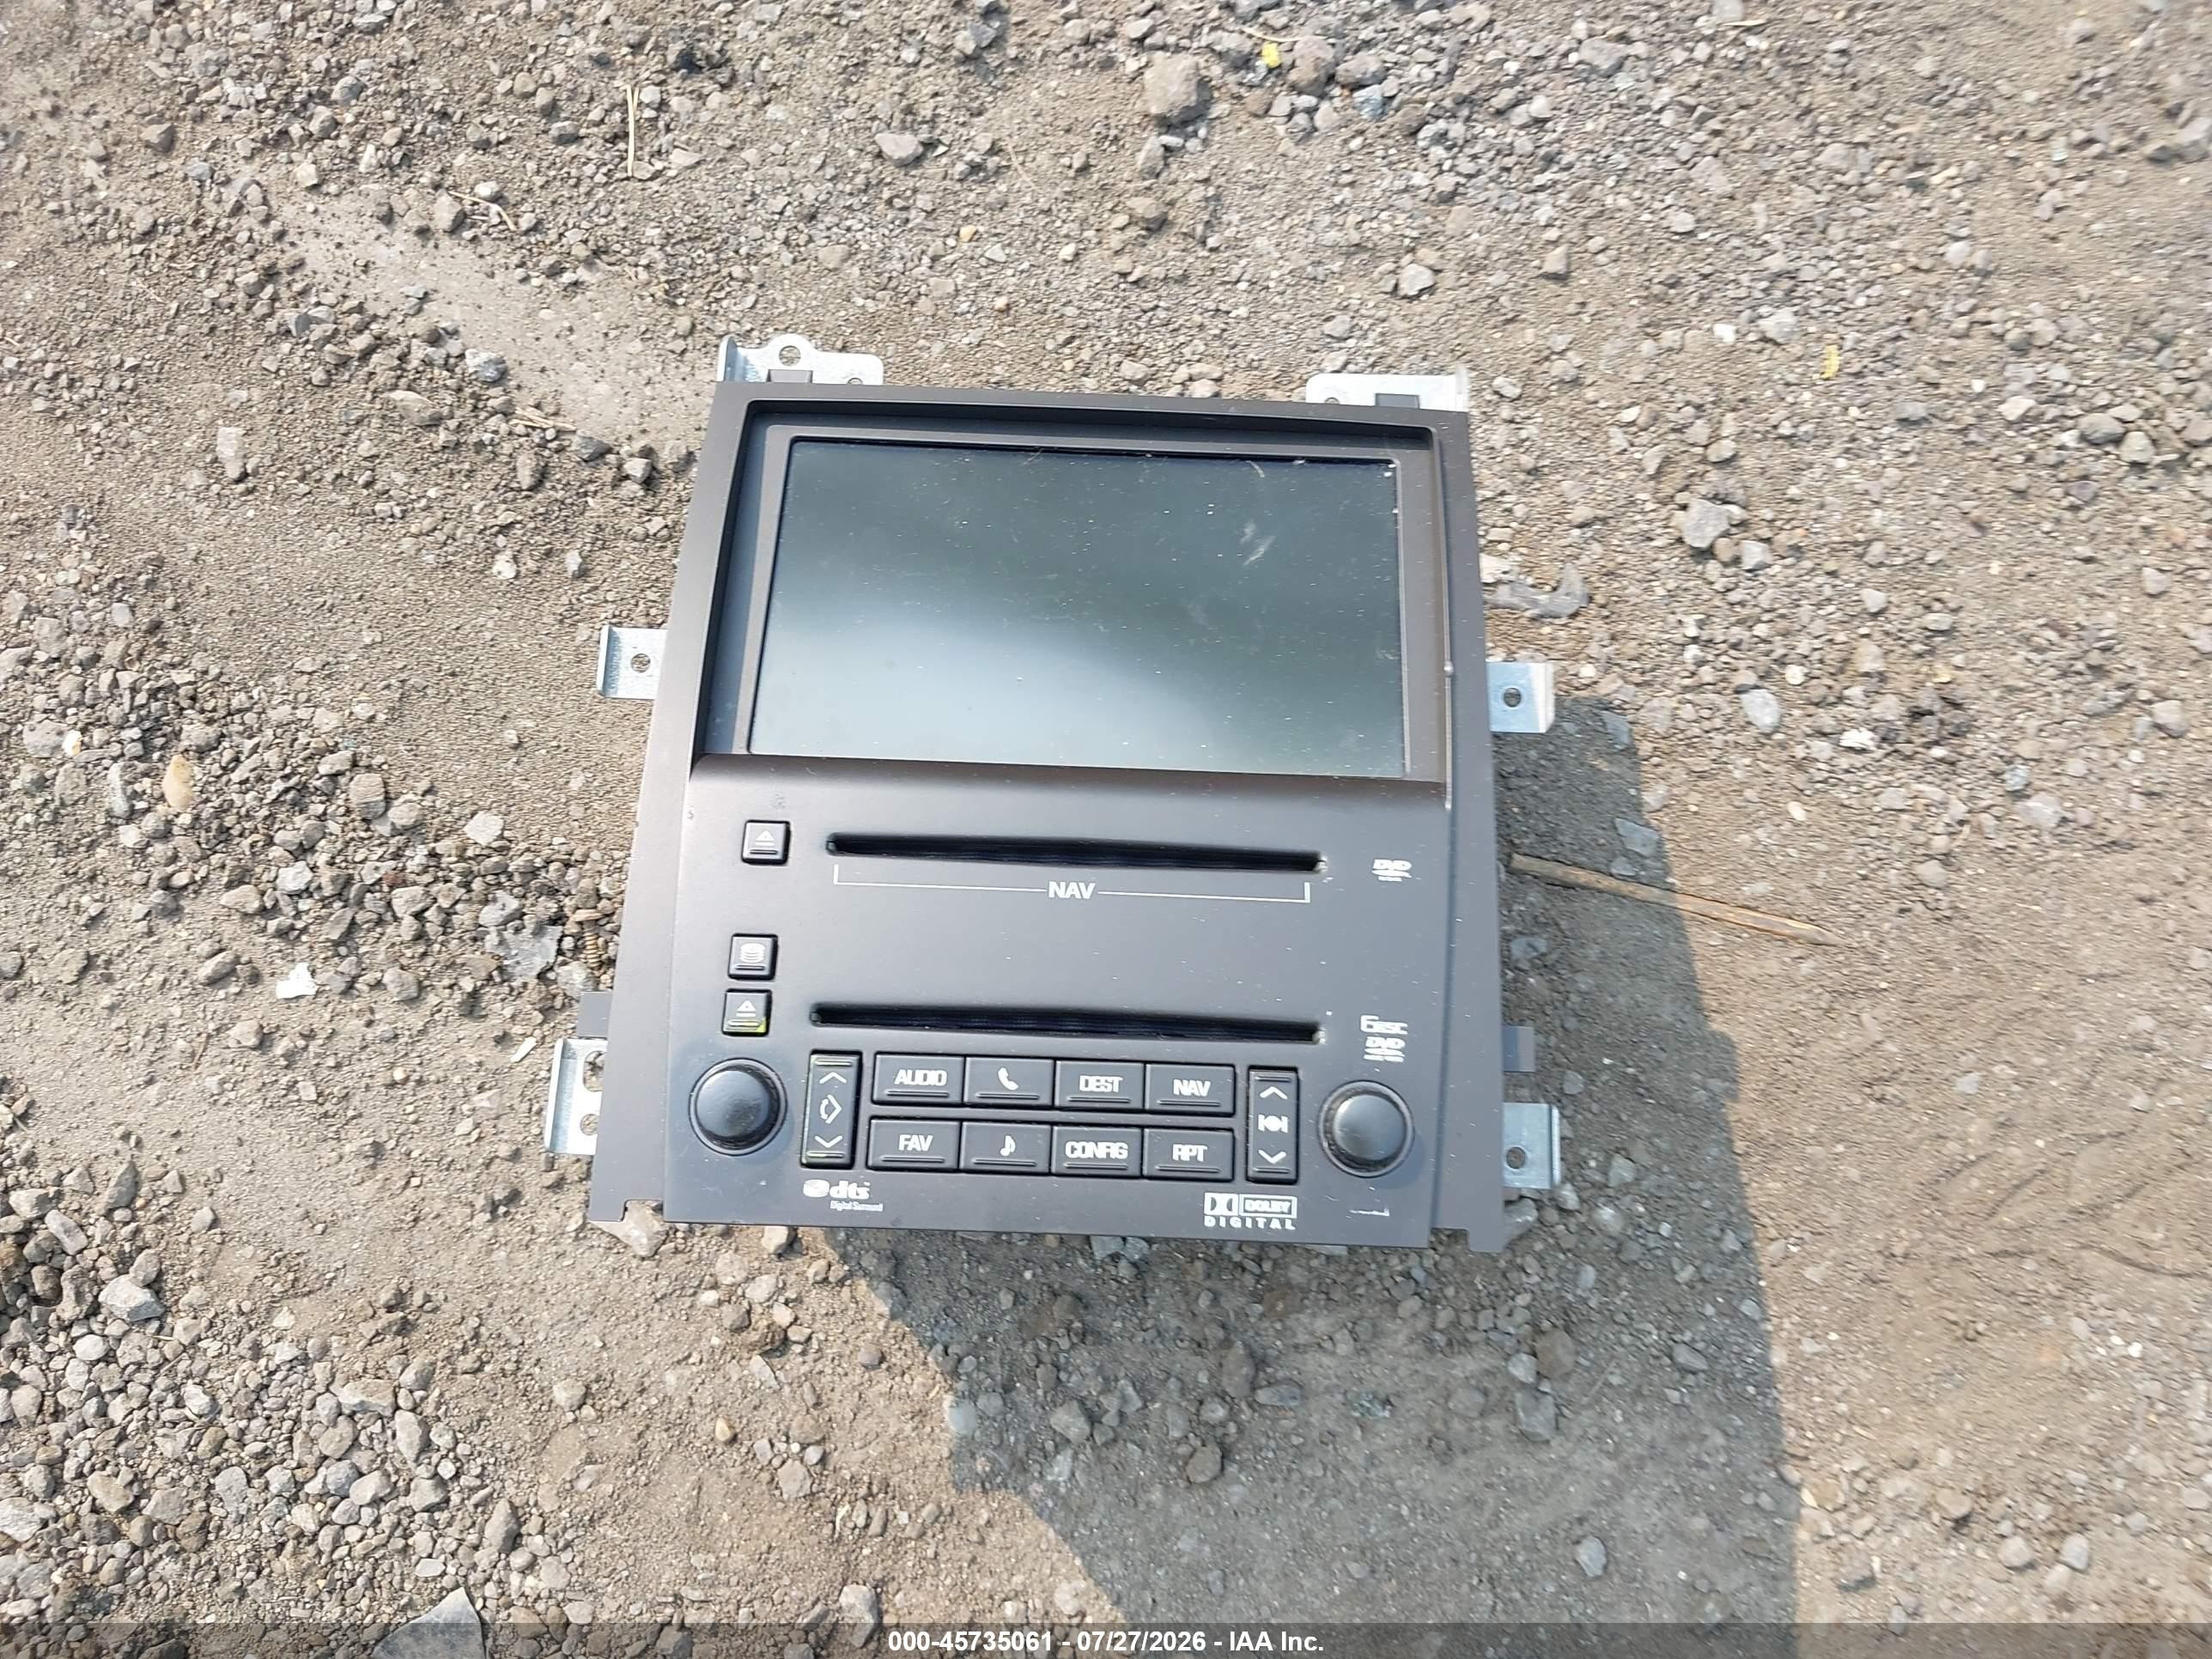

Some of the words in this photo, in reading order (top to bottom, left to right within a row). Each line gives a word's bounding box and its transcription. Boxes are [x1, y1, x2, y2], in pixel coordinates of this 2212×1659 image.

[1048, 881, 1096, 900] NAV
[895, 1070, 946, 1085] AUDIO
[1080, 1076, 1122, 1091] DEST
[1174, 1079, 1210, 1096] NAV
[899, 1135, 933, 1151] FAV
[1066, 1142, 1127, 1158] CONFIG
[1173, 1145, 1206, 1161] RPT
[829, 1180, 871, 1199] dts
[1204, 1215, 1297, 1231] DIGITAL
